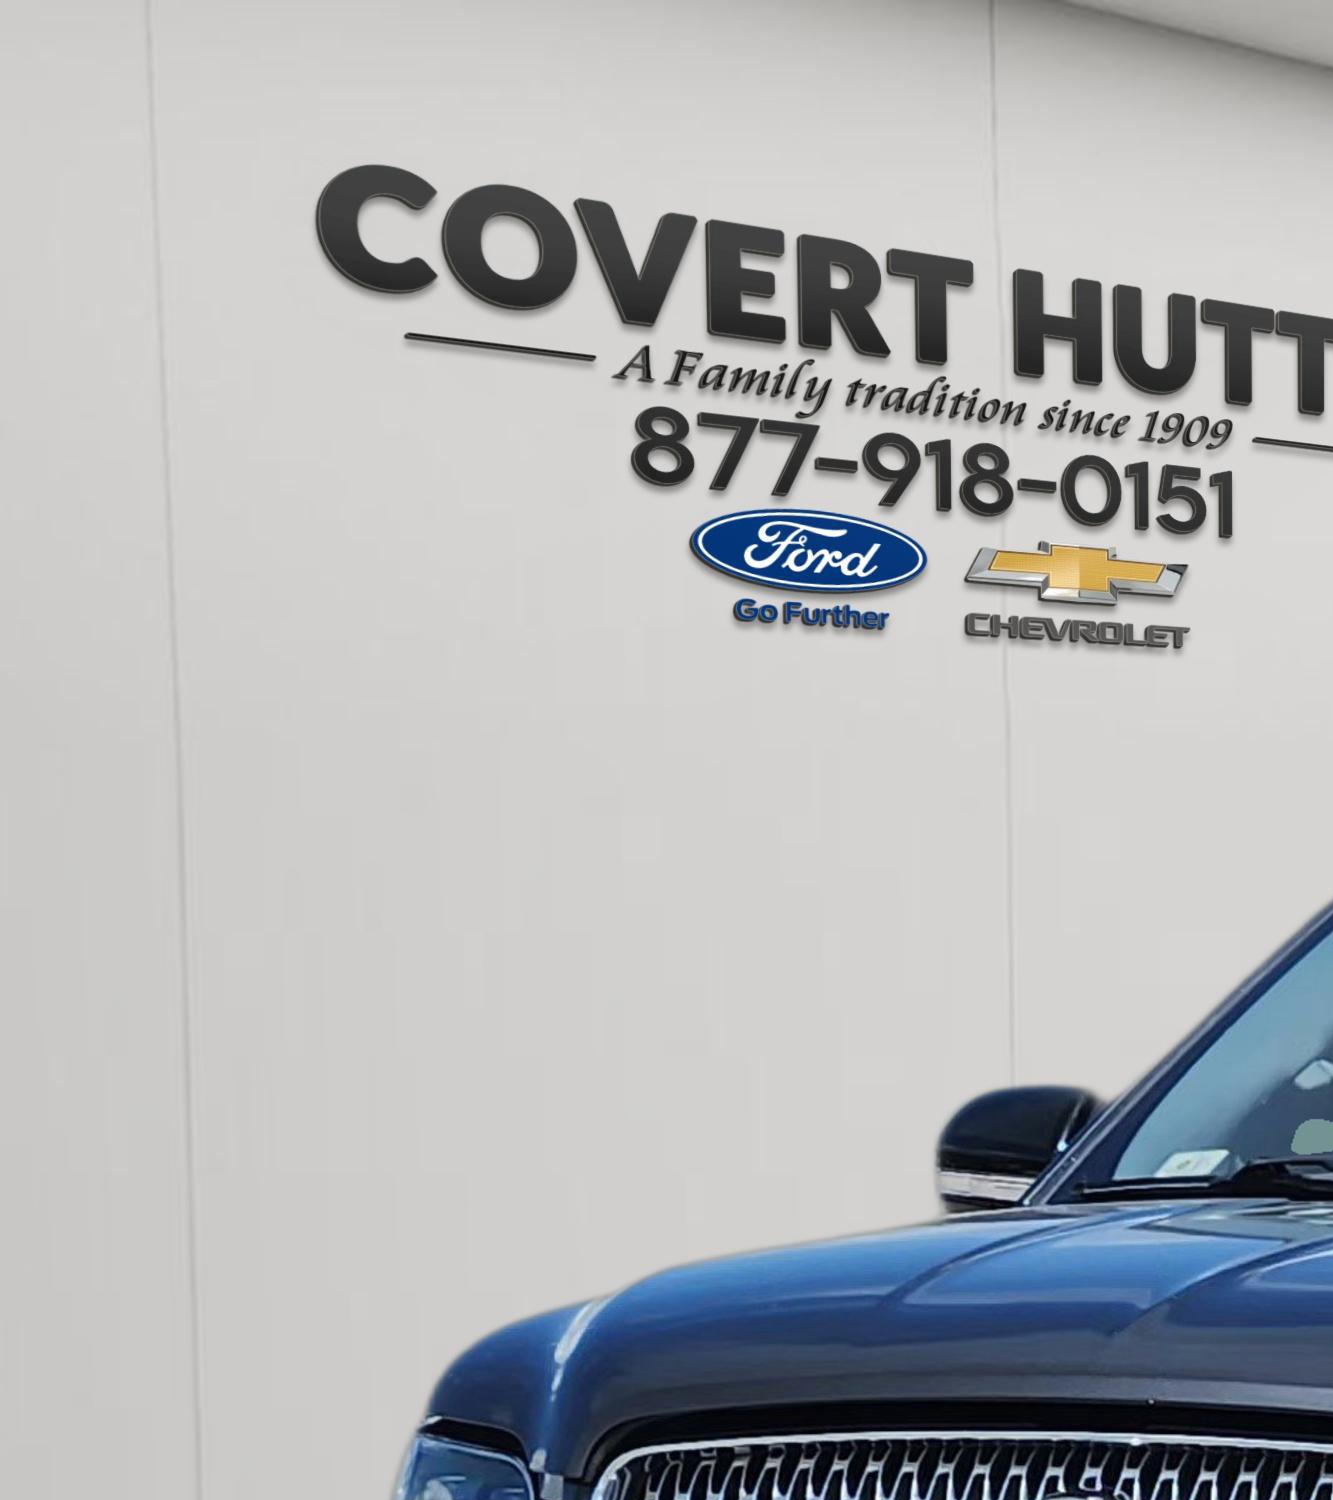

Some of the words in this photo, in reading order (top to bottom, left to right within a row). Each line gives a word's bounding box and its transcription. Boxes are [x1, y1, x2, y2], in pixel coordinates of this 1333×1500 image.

[316, 165, 973, 366] COVERT
[612, 345, 654, 383] A
[664, 350, 832, 419] Family
[846, 379, 1026, 426] tradition
[1038, 400, 1130, 438] since
[1139, 411, 1233, 450] 1909
[631, 407, 1232, 539] 877-918-0151
[743, 519, 877, 580] Ford
[733, 599, 778, 626] Go
[783, 601, 889, 632] Further
[965, 613, 1190, 649] CHEVROLET
